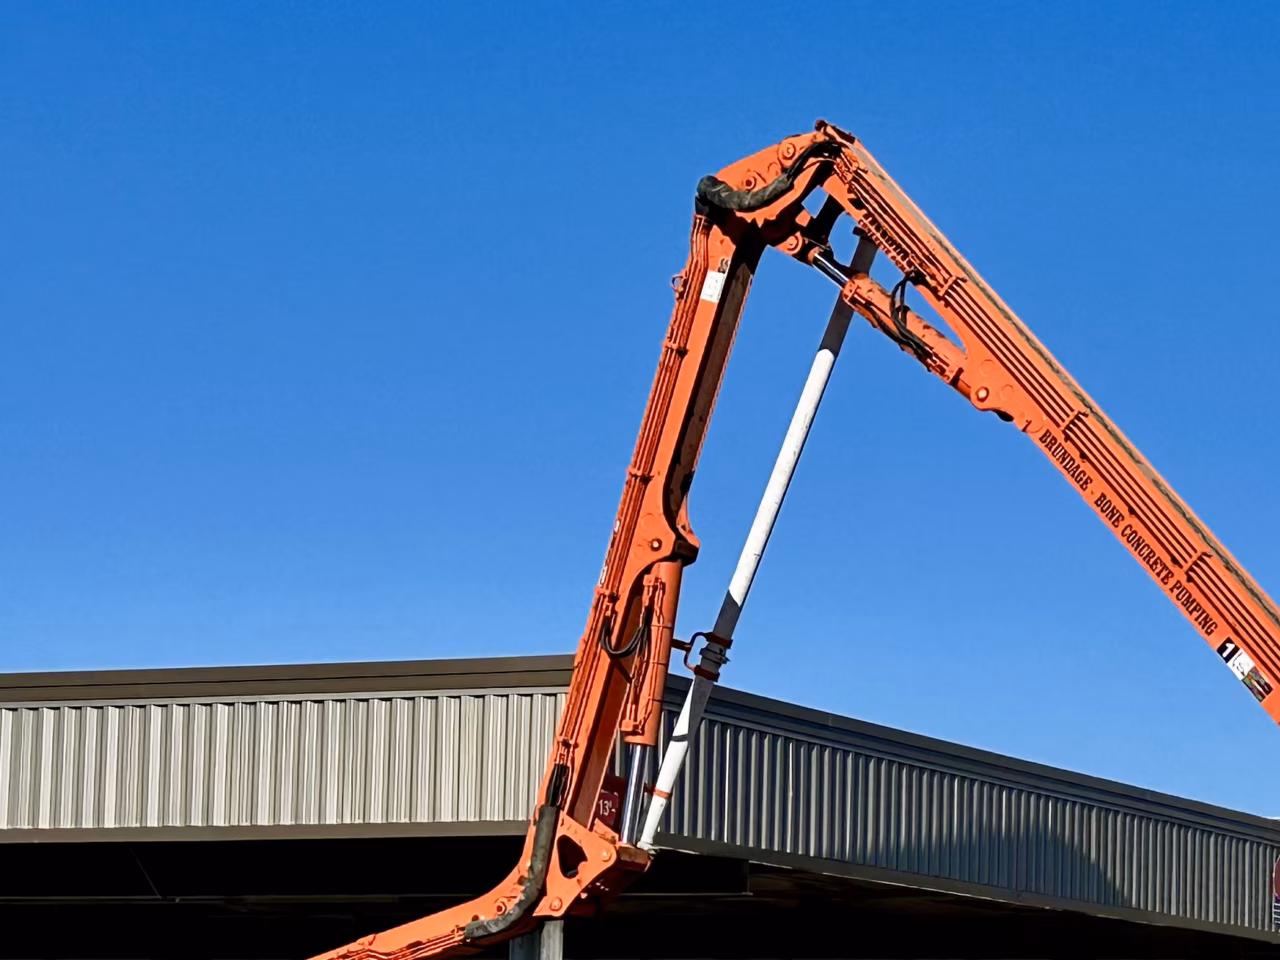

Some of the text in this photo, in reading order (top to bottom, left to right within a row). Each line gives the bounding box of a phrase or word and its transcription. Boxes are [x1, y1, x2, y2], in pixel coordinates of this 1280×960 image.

[1038, 428, 1218, 637] BRUNDAGE BONE CONCRETE PUMPING
[1222, 642, 1236, 659] 1
